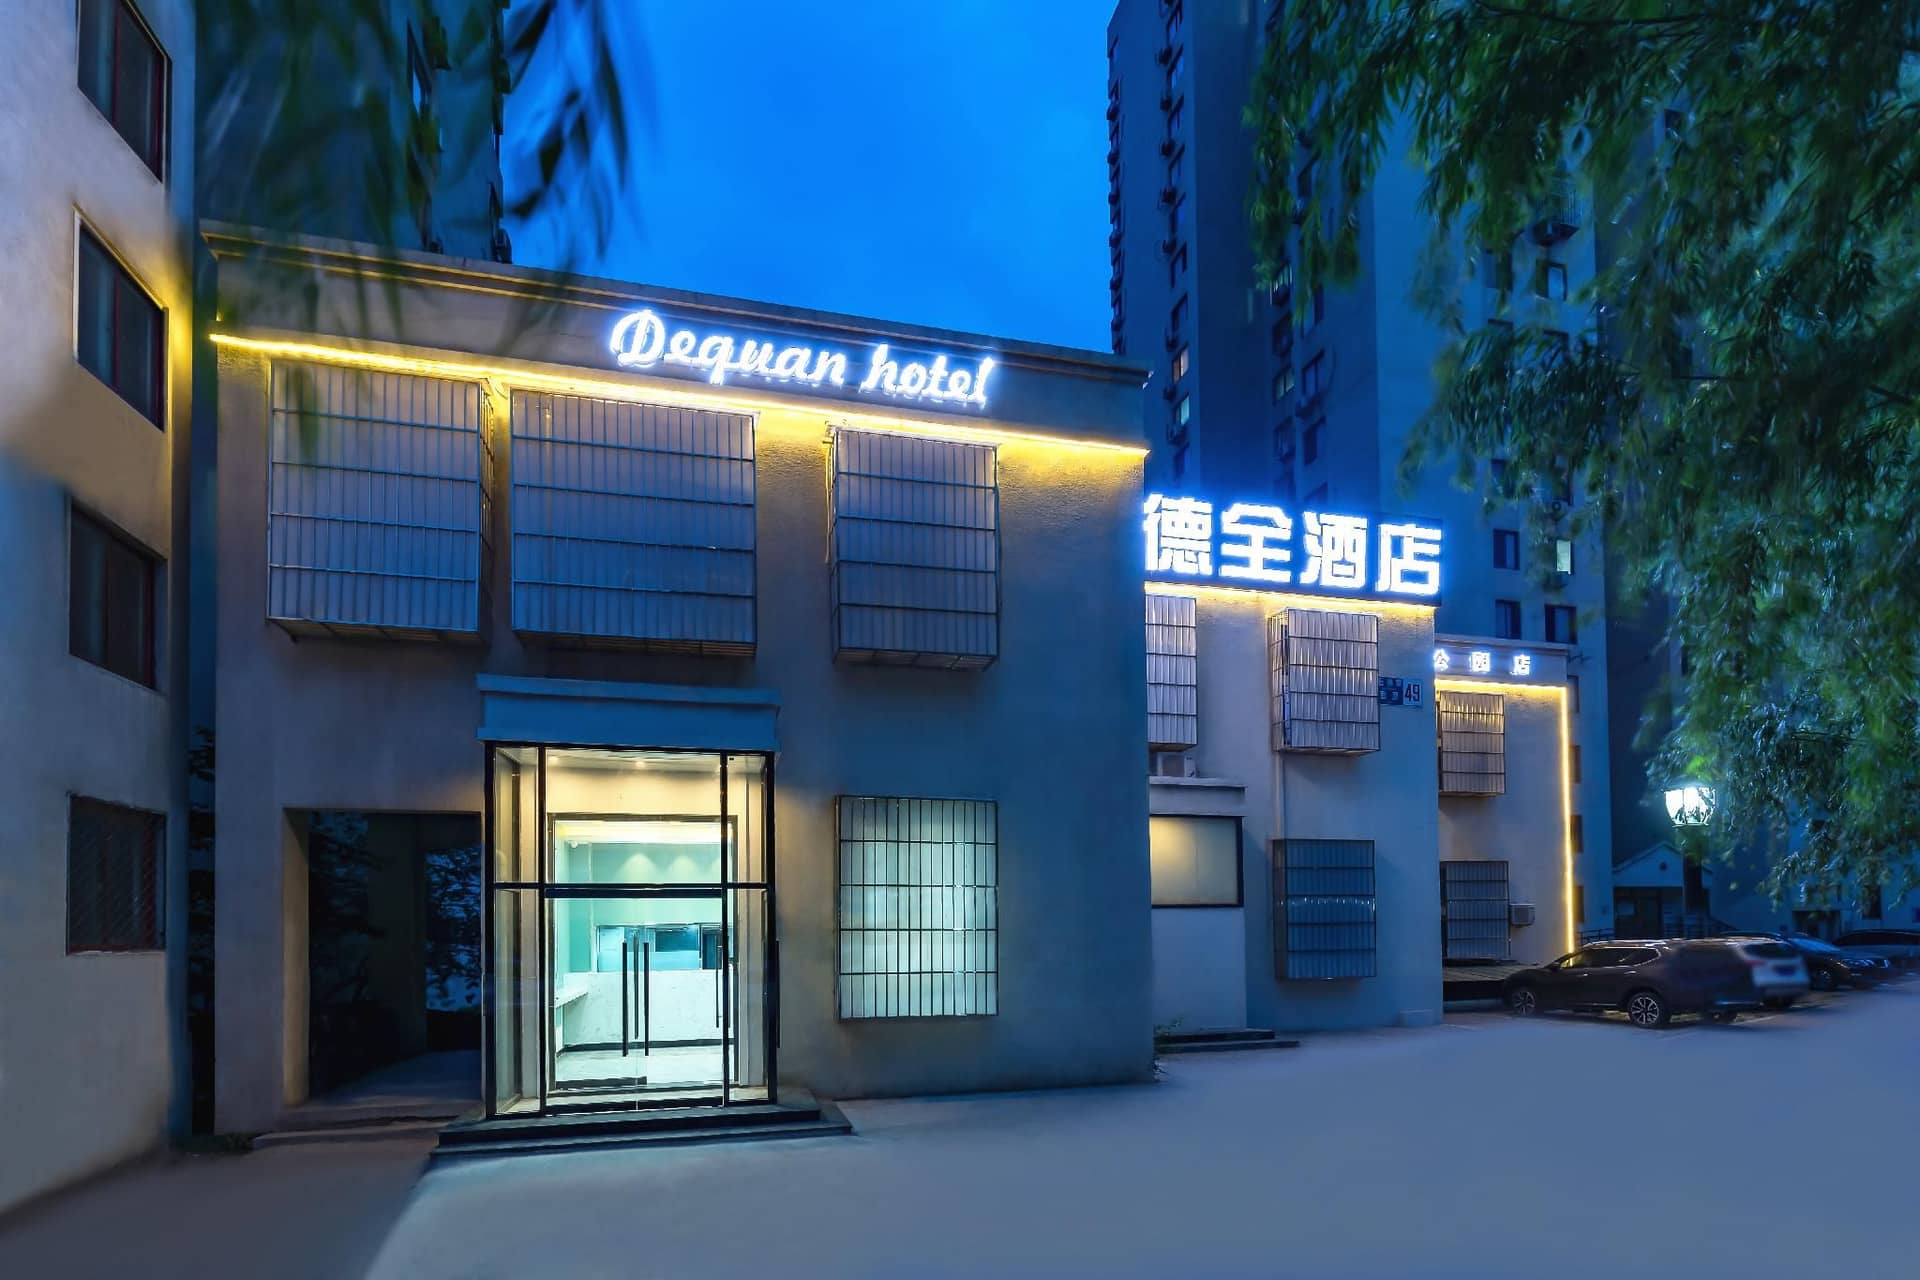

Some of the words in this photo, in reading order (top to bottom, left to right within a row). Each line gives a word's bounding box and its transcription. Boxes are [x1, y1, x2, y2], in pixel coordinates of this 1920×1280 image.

[610, 309, 845, 384] Dequan
[859, 343, 995, 406] hotel
[1143, 493, 1442, 595] 德全酒店
[1404, 683, 1421, 702] 49
